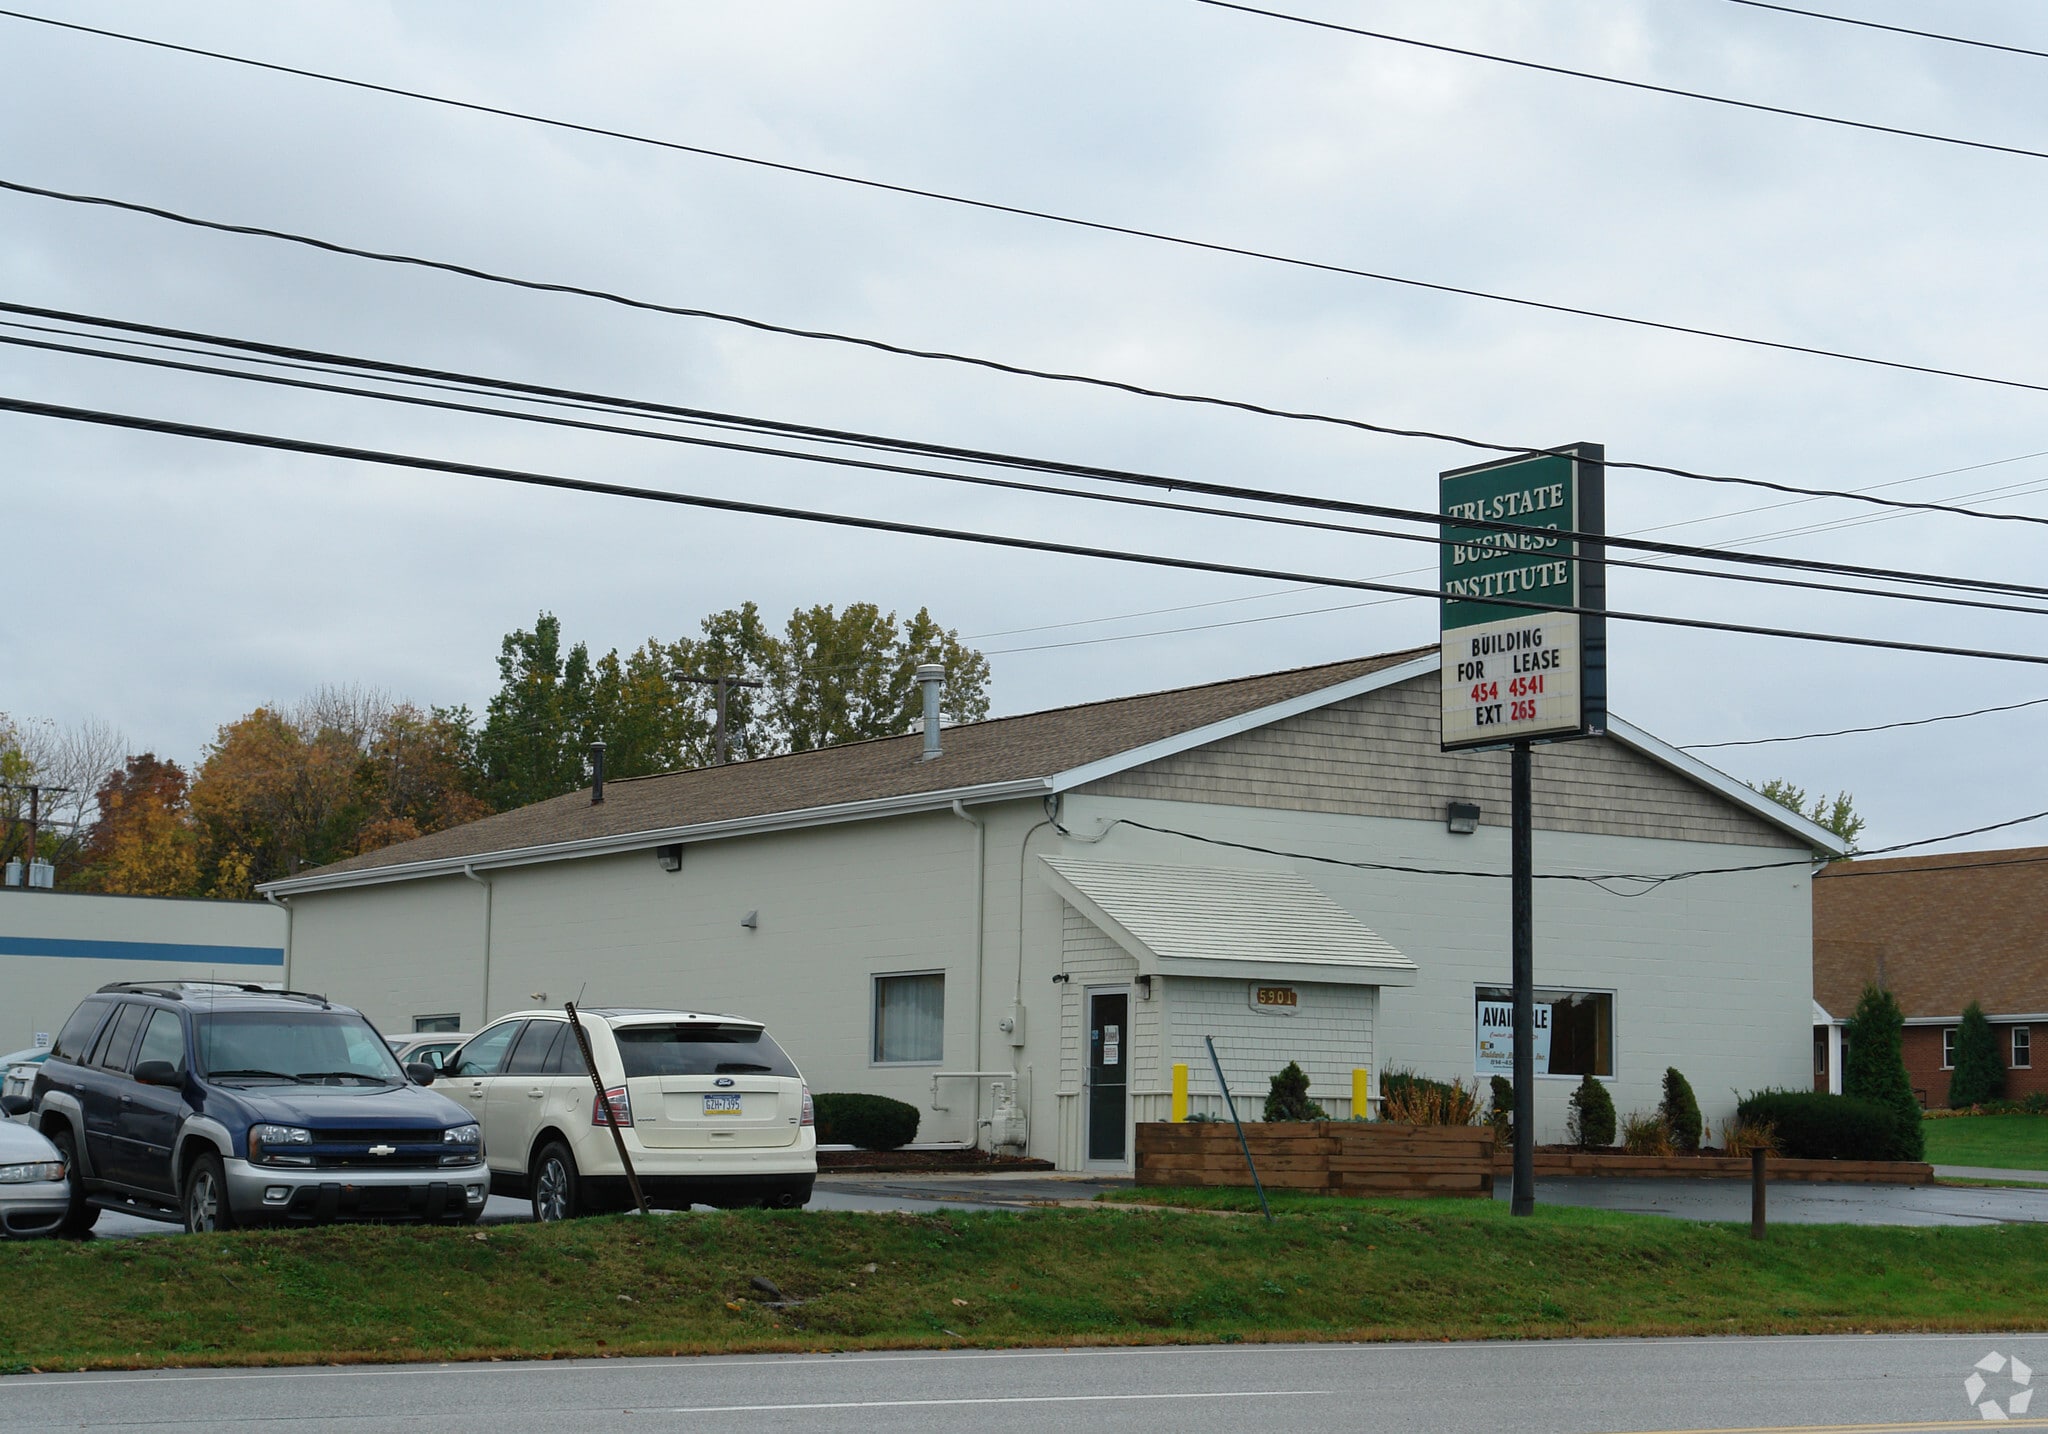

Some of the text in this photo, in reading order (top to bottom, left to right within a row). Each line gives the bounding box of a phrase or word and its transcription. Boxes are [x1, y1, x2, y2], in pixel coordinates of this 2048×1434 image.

[1449, 483, 1563, 527] TRI-STATE
[1453, 523, 1558, 565] BUSINESS
[1446, 561, 1568, 604] INSTITUTE
[1472, 628, 1542, 657] BUILDING
[1458, 649, 1560, 682] FOR LEASE
[1471, 675, 1543, 703] 454 4541
[1476, 699, 1536, 726] EXT 265
[1260, 990, 1292, 1004] 5901
[1483, 1007, 1547, 1028] AVAILE
